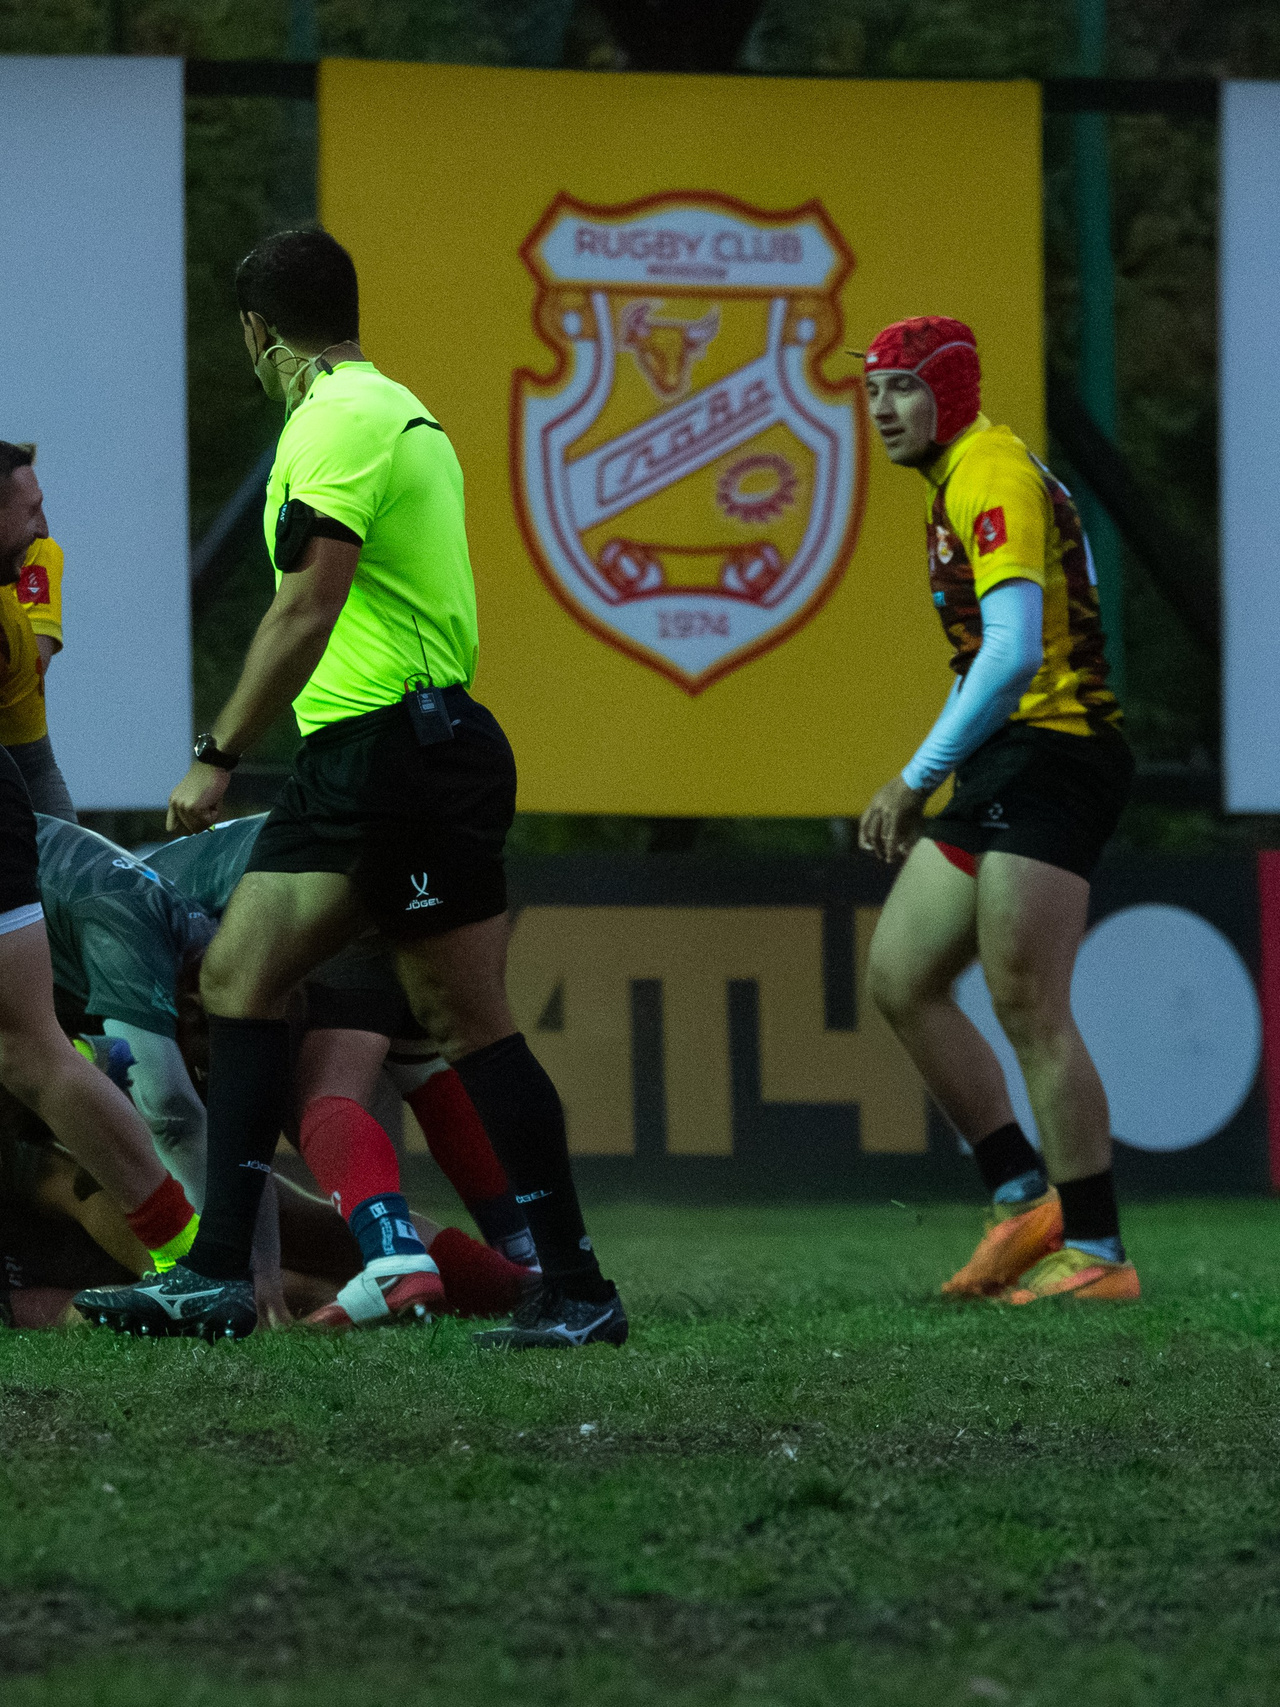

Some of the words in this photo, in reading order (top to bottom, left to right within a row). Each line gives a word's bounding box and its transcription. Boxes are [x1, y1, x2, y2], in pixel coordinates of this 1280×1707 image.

[575, 226, 706, 261] RUGBY
[711, 229, 804, 264] CLUB
[657, 609, 730, 638] 1974
[404, 897, 444, 911] JÖGEL
[404, 905, 930, 1154] АТЧ
